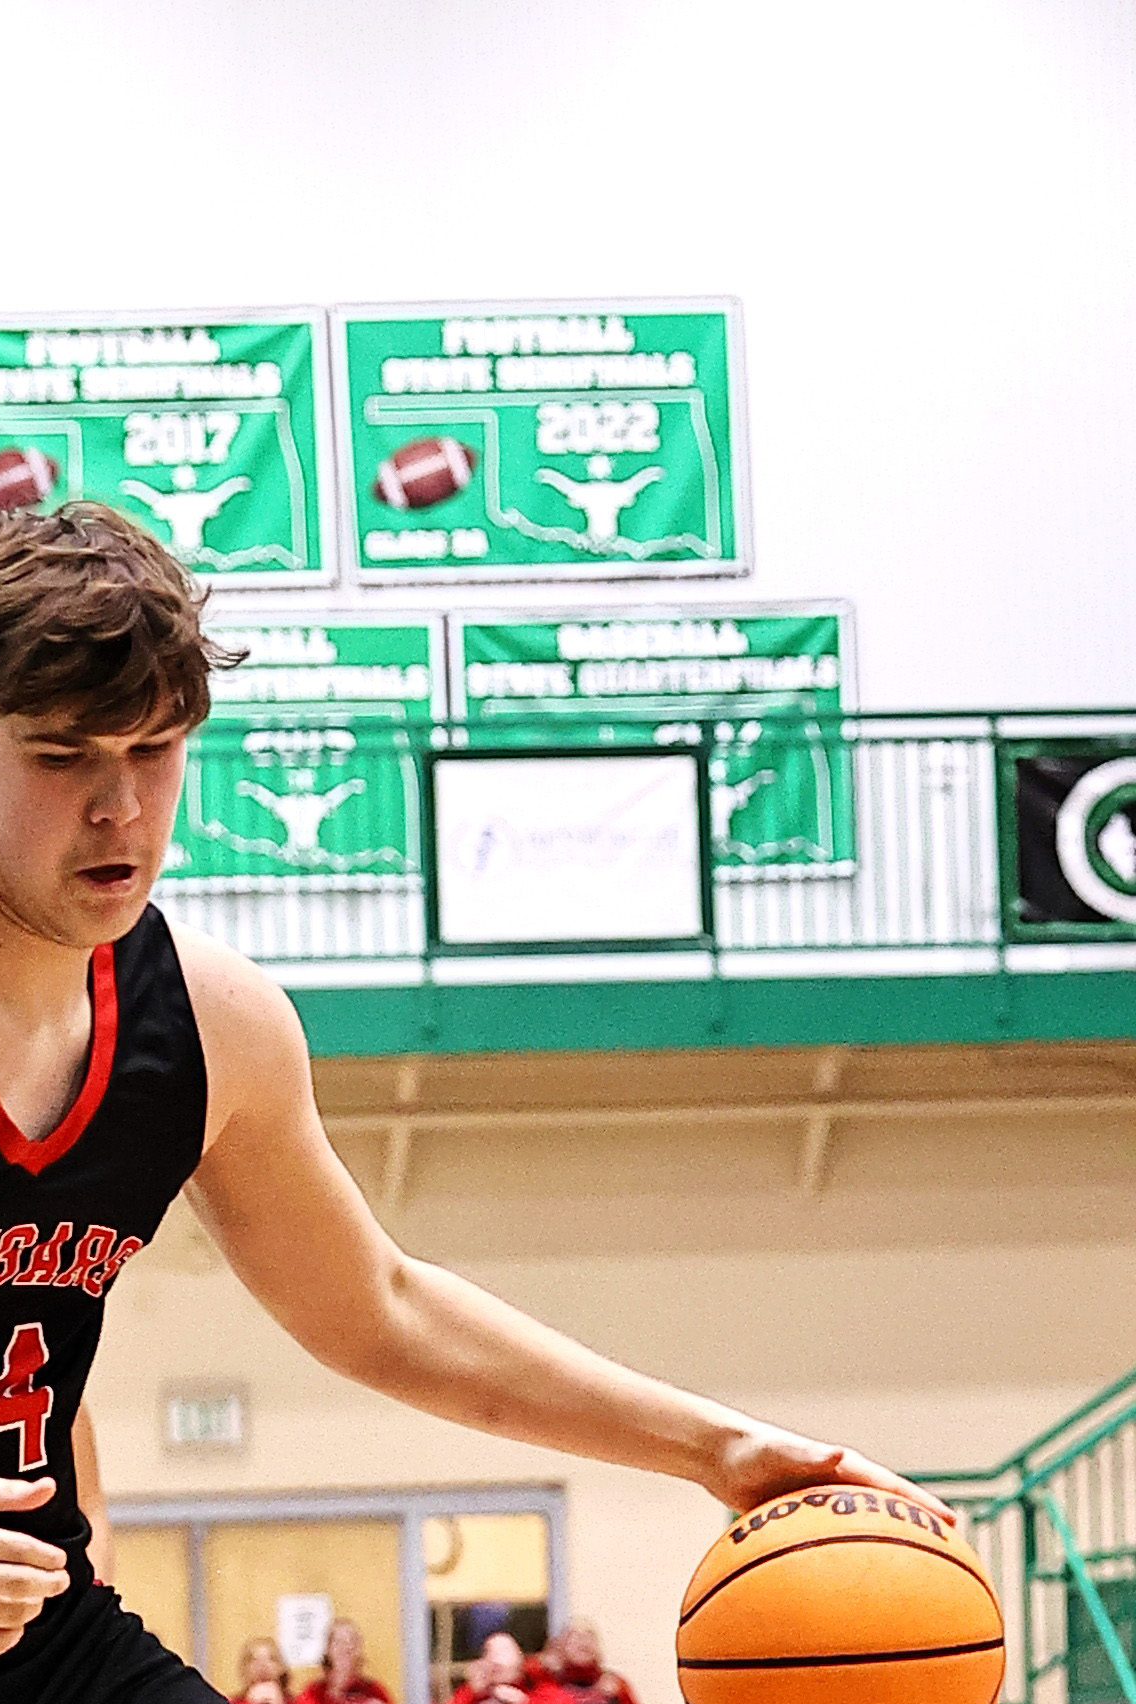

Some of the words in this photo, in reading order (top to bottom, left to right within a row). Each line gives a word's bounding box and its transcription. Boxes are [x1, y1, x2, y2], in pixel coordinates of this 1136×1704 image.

[27, 328, 218, 365] FOOTBALL
[444, 315, 632, 353] FOOTBALL
[384, 359, 490, 391] STATE
[127, 411, 238, 464] 2017
[539, 401, 657, 452] 2022
[729, 1489, 948, 1545] Wilson
